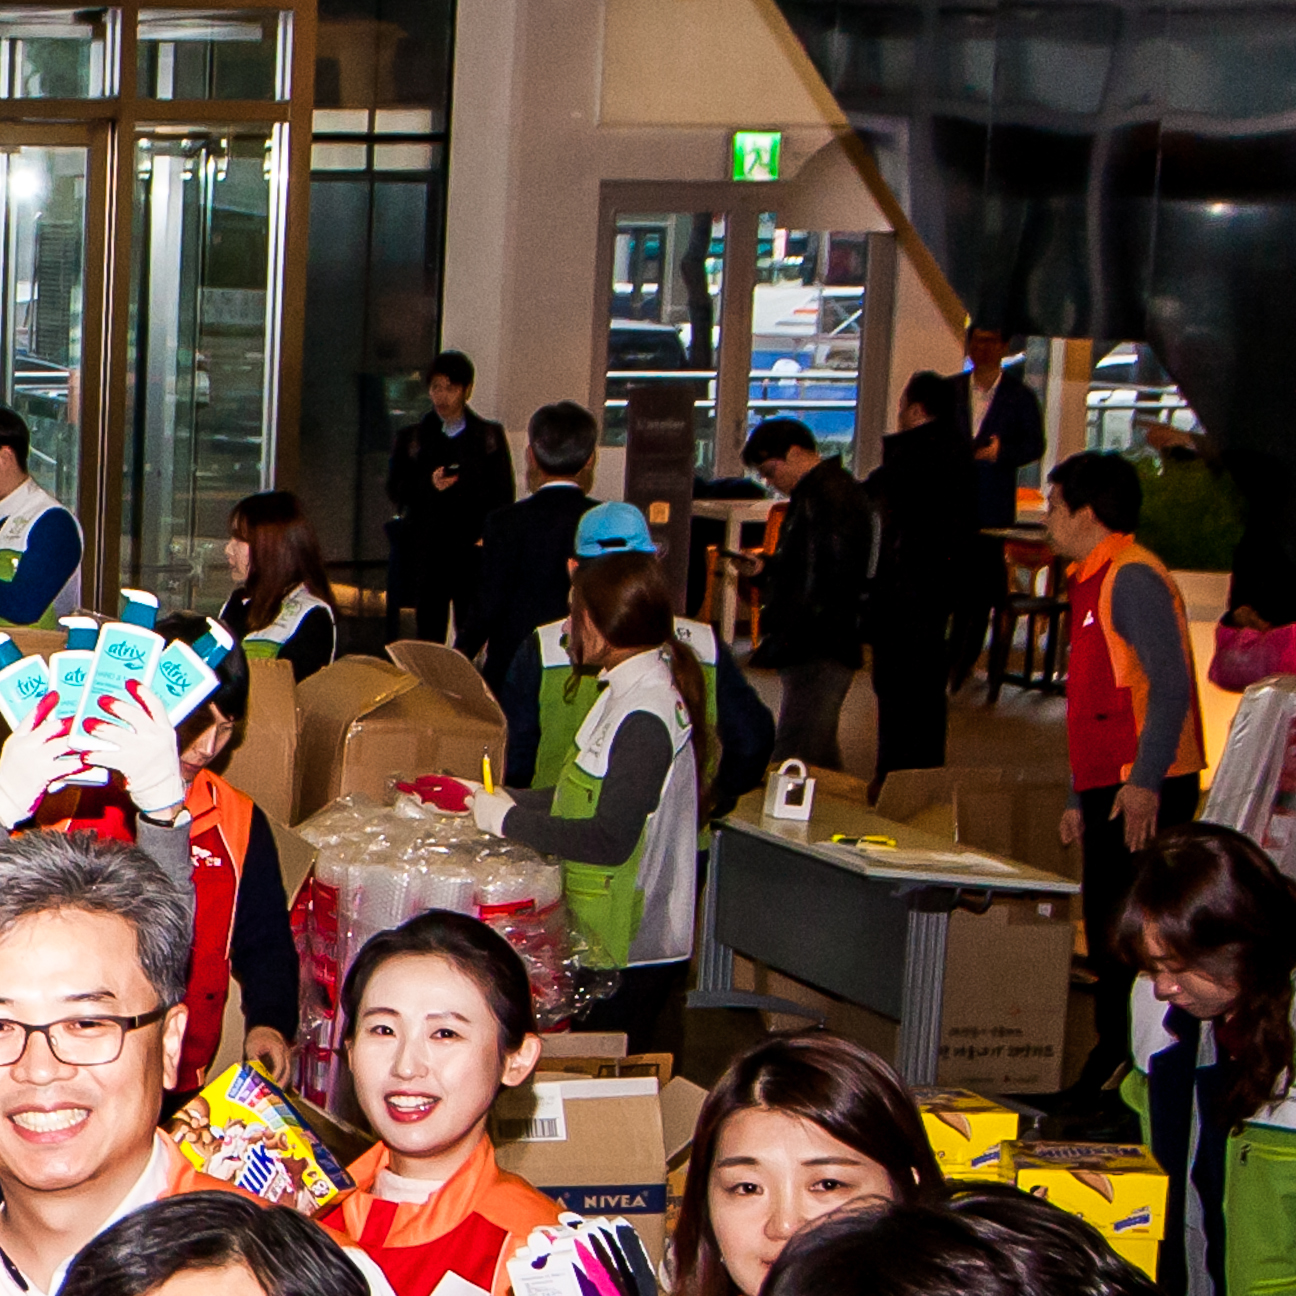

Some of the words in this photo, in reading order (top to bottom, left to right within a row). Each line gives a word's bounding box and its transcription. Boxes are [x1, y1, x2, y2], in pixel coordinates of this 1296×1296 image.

[108, 640, 146, 664] atrix
[63, 666, 87, 683] atr
[160, 659, 193, 691] atrix
[584, 1193, 645, 1210] NIVEA
